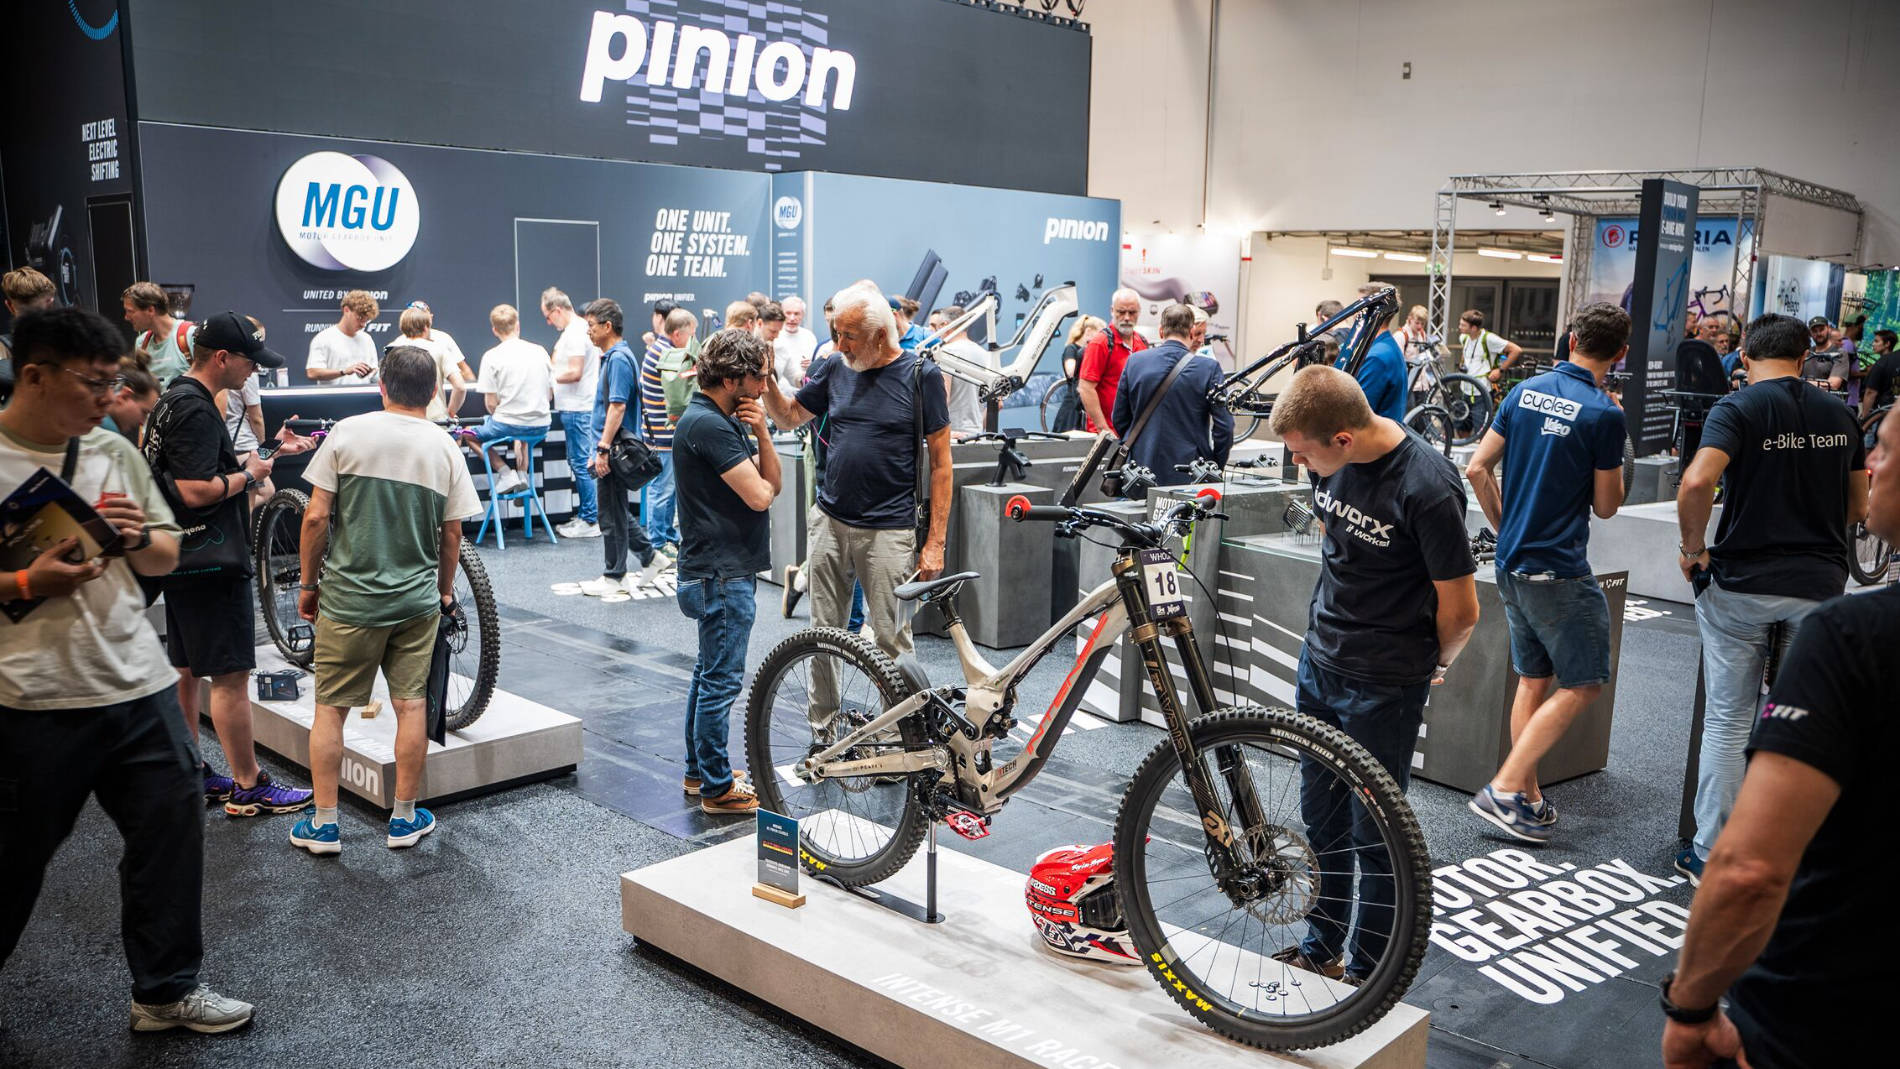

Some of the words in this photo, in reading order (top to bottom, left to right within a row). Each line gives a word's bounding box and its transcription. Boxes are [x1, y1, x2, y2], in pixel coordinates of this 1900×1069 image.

[579, 10, 856, 111] pinion
[82, 122, 97, 142] NEXT
[98, 118, 116, 139] LEVEL
[89, 139, 117, 161] ELECTRIC
[91, 160, 119, 181] SHIFTING
[302, 182, 400, 231] MGU
[779, 205, 798, 218] MGU
[656, 208, 689, 231] ONE
[692, 210, 731, 233] UNIT.
[1044, 217, 1109, 245] pinion
[650, 231, 685, 253] ONE
[687, 233, 750, 256] SYSTEM.
[645, 255, 680, 276] ONE
[683, 256, 728, 278] TEAM.
[303, 290, 335, 300] UNITED
[1763, 432, 1806, 451] e-Bike
[1809, 433, 1849, 449] Team
[1154, 496, 1178, 510] MOTO
[1155, 570, 1176, 596] 18
[1026, 611, 1108, 755] INTENSE
[1270, 727, 1311, 746] MINION
[1432, 848, 1578, 916] OTOR.
[1026, 898, 1076, 918] TENSE
[1428, 858, 1689, 963] GEARBOX.
[1150, 952, 1213, 1012] MAXXIS
[873, 972, 993, 1023] INTENSE
